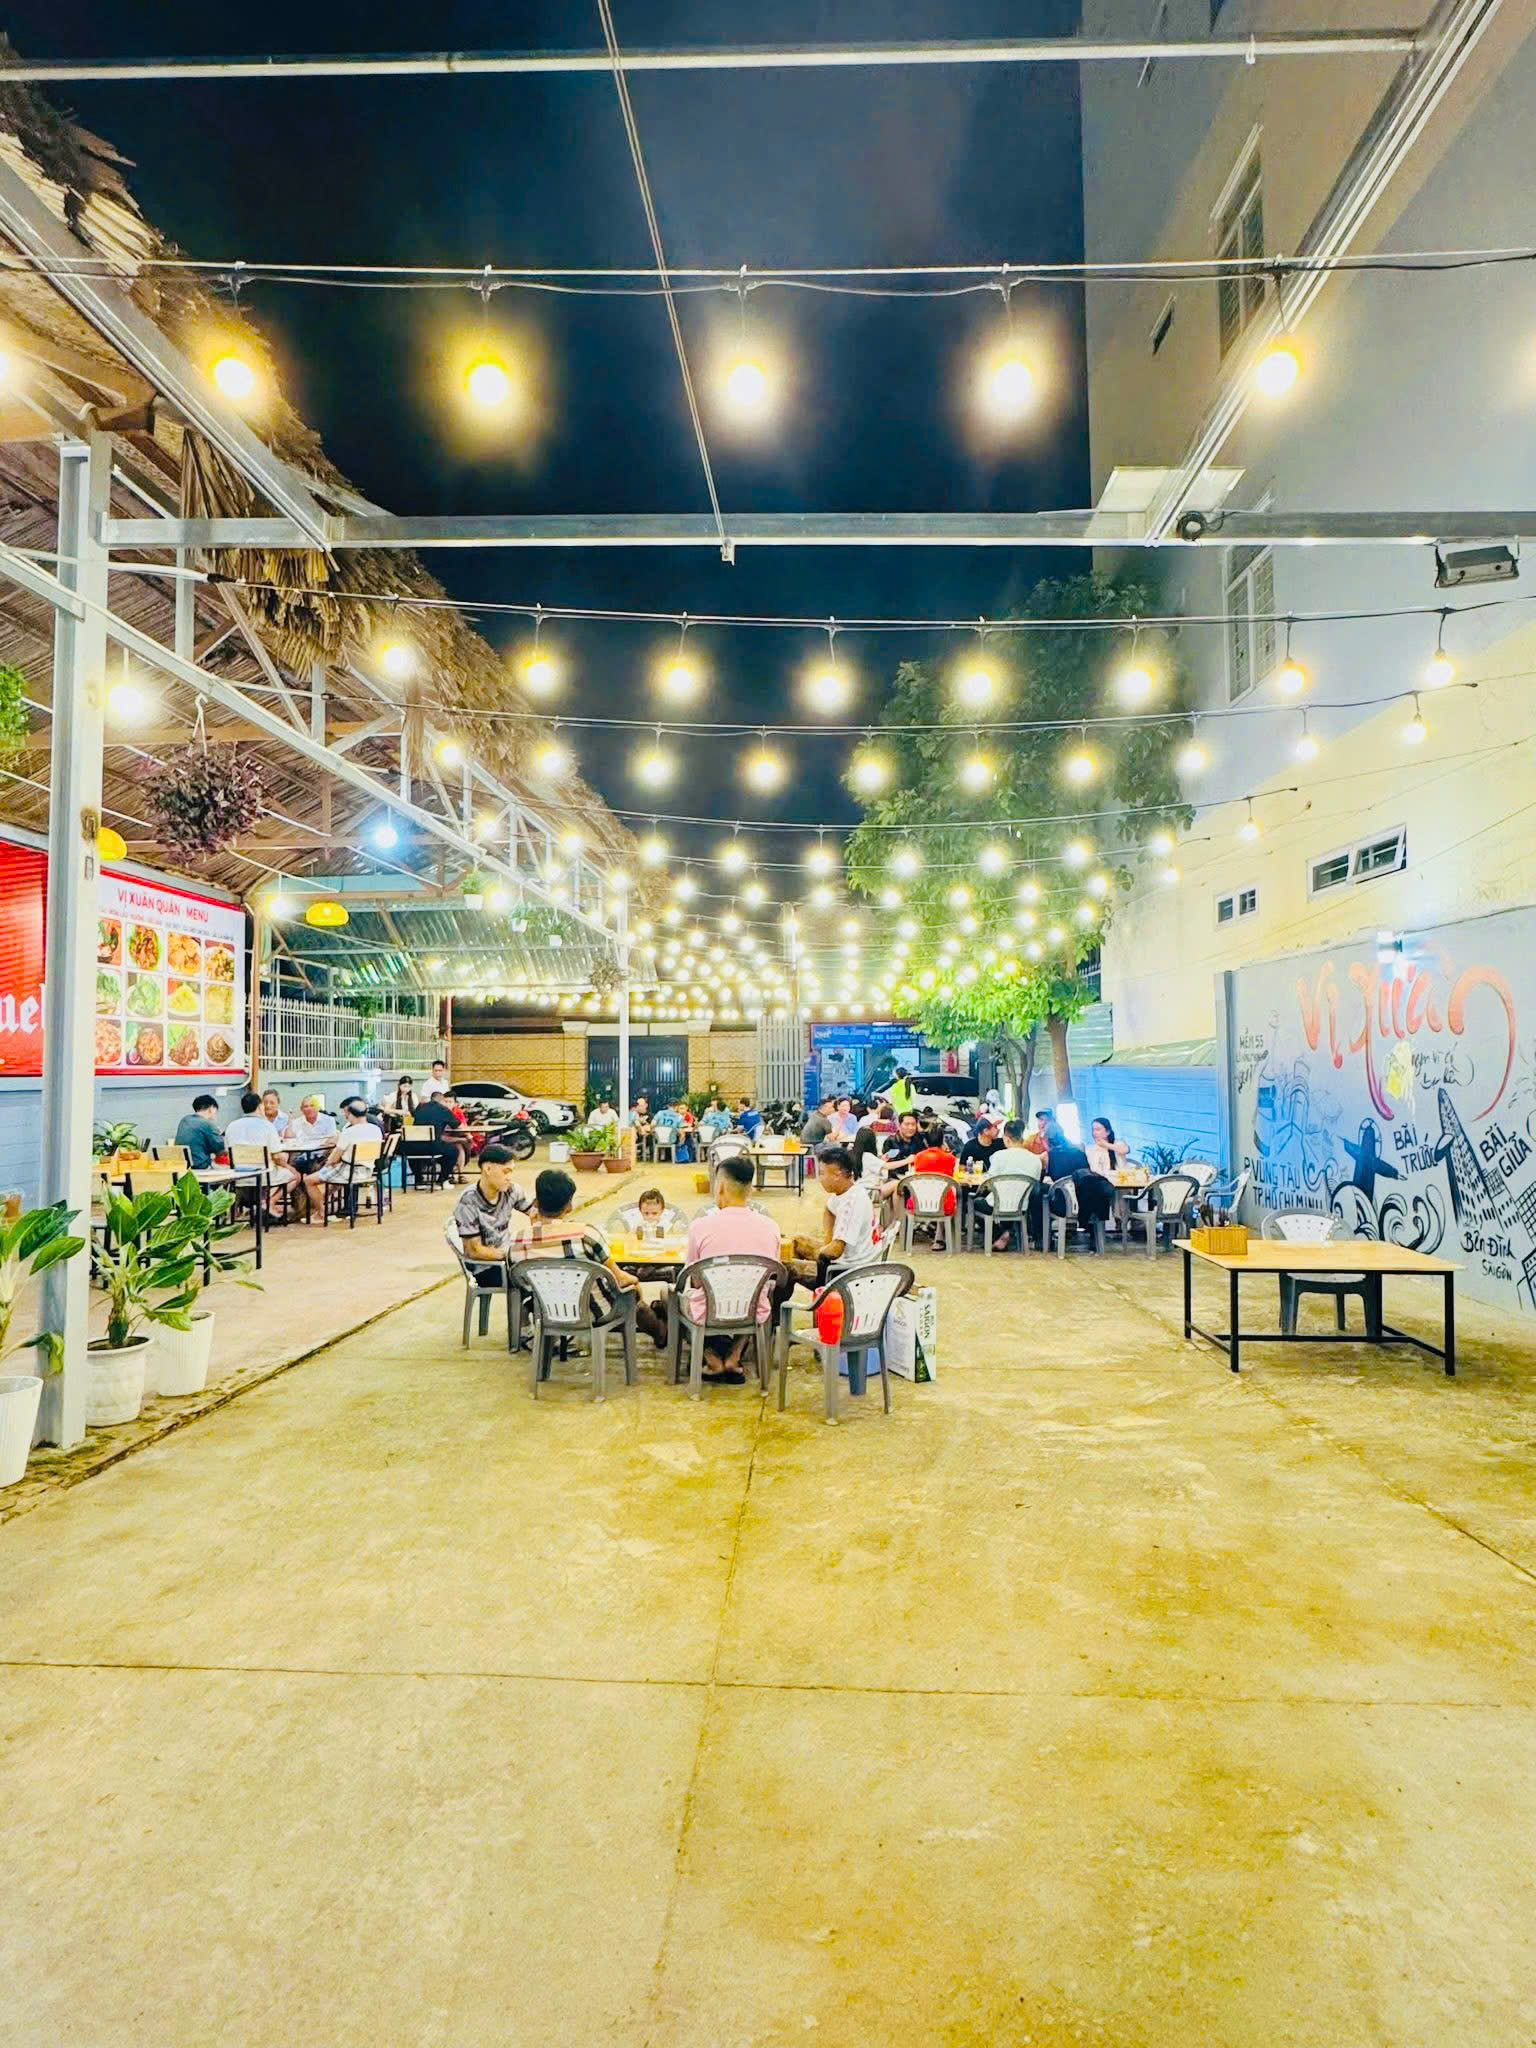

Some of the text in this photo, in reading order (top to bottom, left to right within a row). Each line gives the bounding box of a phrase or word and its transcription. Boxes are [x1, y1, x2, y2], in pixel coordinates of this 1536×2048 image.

[186, 907, 209, 923] MENU
[1393, 1123, 1418, 1151] BÃI
[1479, 1122, 1508, 1163] BÃI
[1401, 1133, 1438, 1174] TRƯỚC
[1279, 1161, 1300, 1189] TÀU
